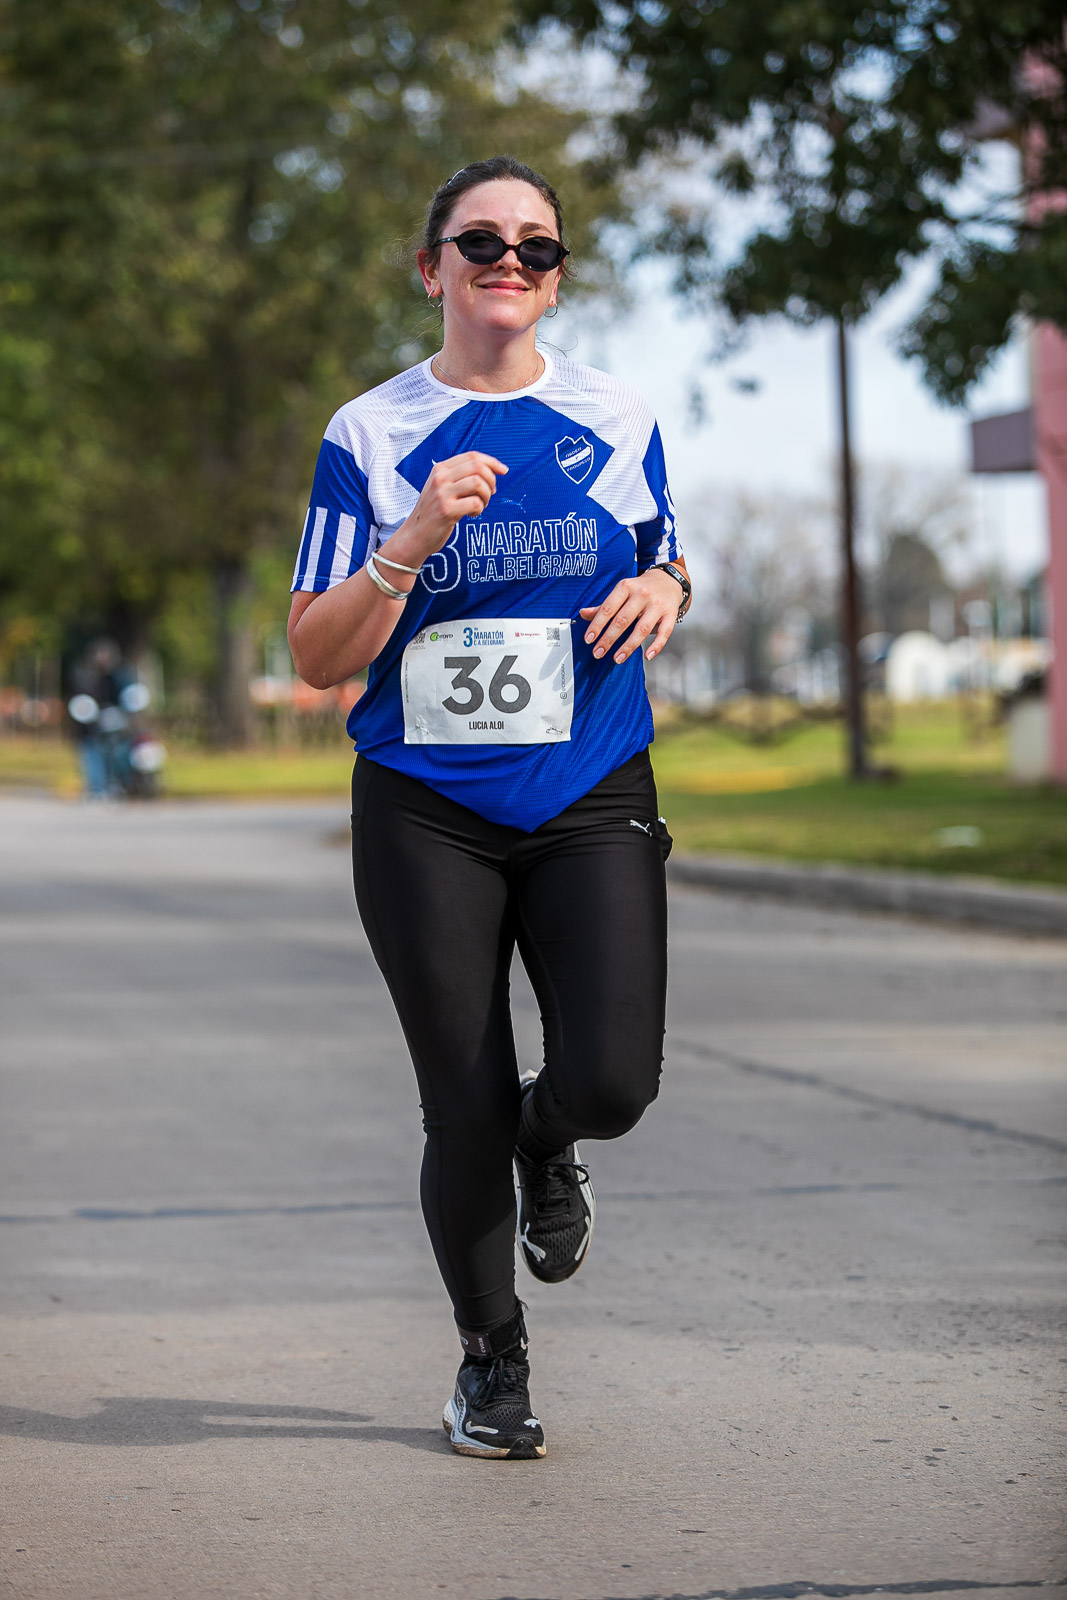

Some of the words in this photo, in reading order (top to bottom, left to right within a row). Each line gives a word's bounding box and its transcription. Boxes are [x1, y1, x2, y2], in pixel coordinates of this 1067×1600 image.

[420, 520, 462, 594] 3
[465, 511, 598, 558] MARATÓN
[463, 626, 473, 648] 3
[473, 629, 504, 640] MARATÓN
[441, 654, 532, 716] 36
[468, 720, 488, 731] LUCIA
[489, 720, 505, 730] ALOI
